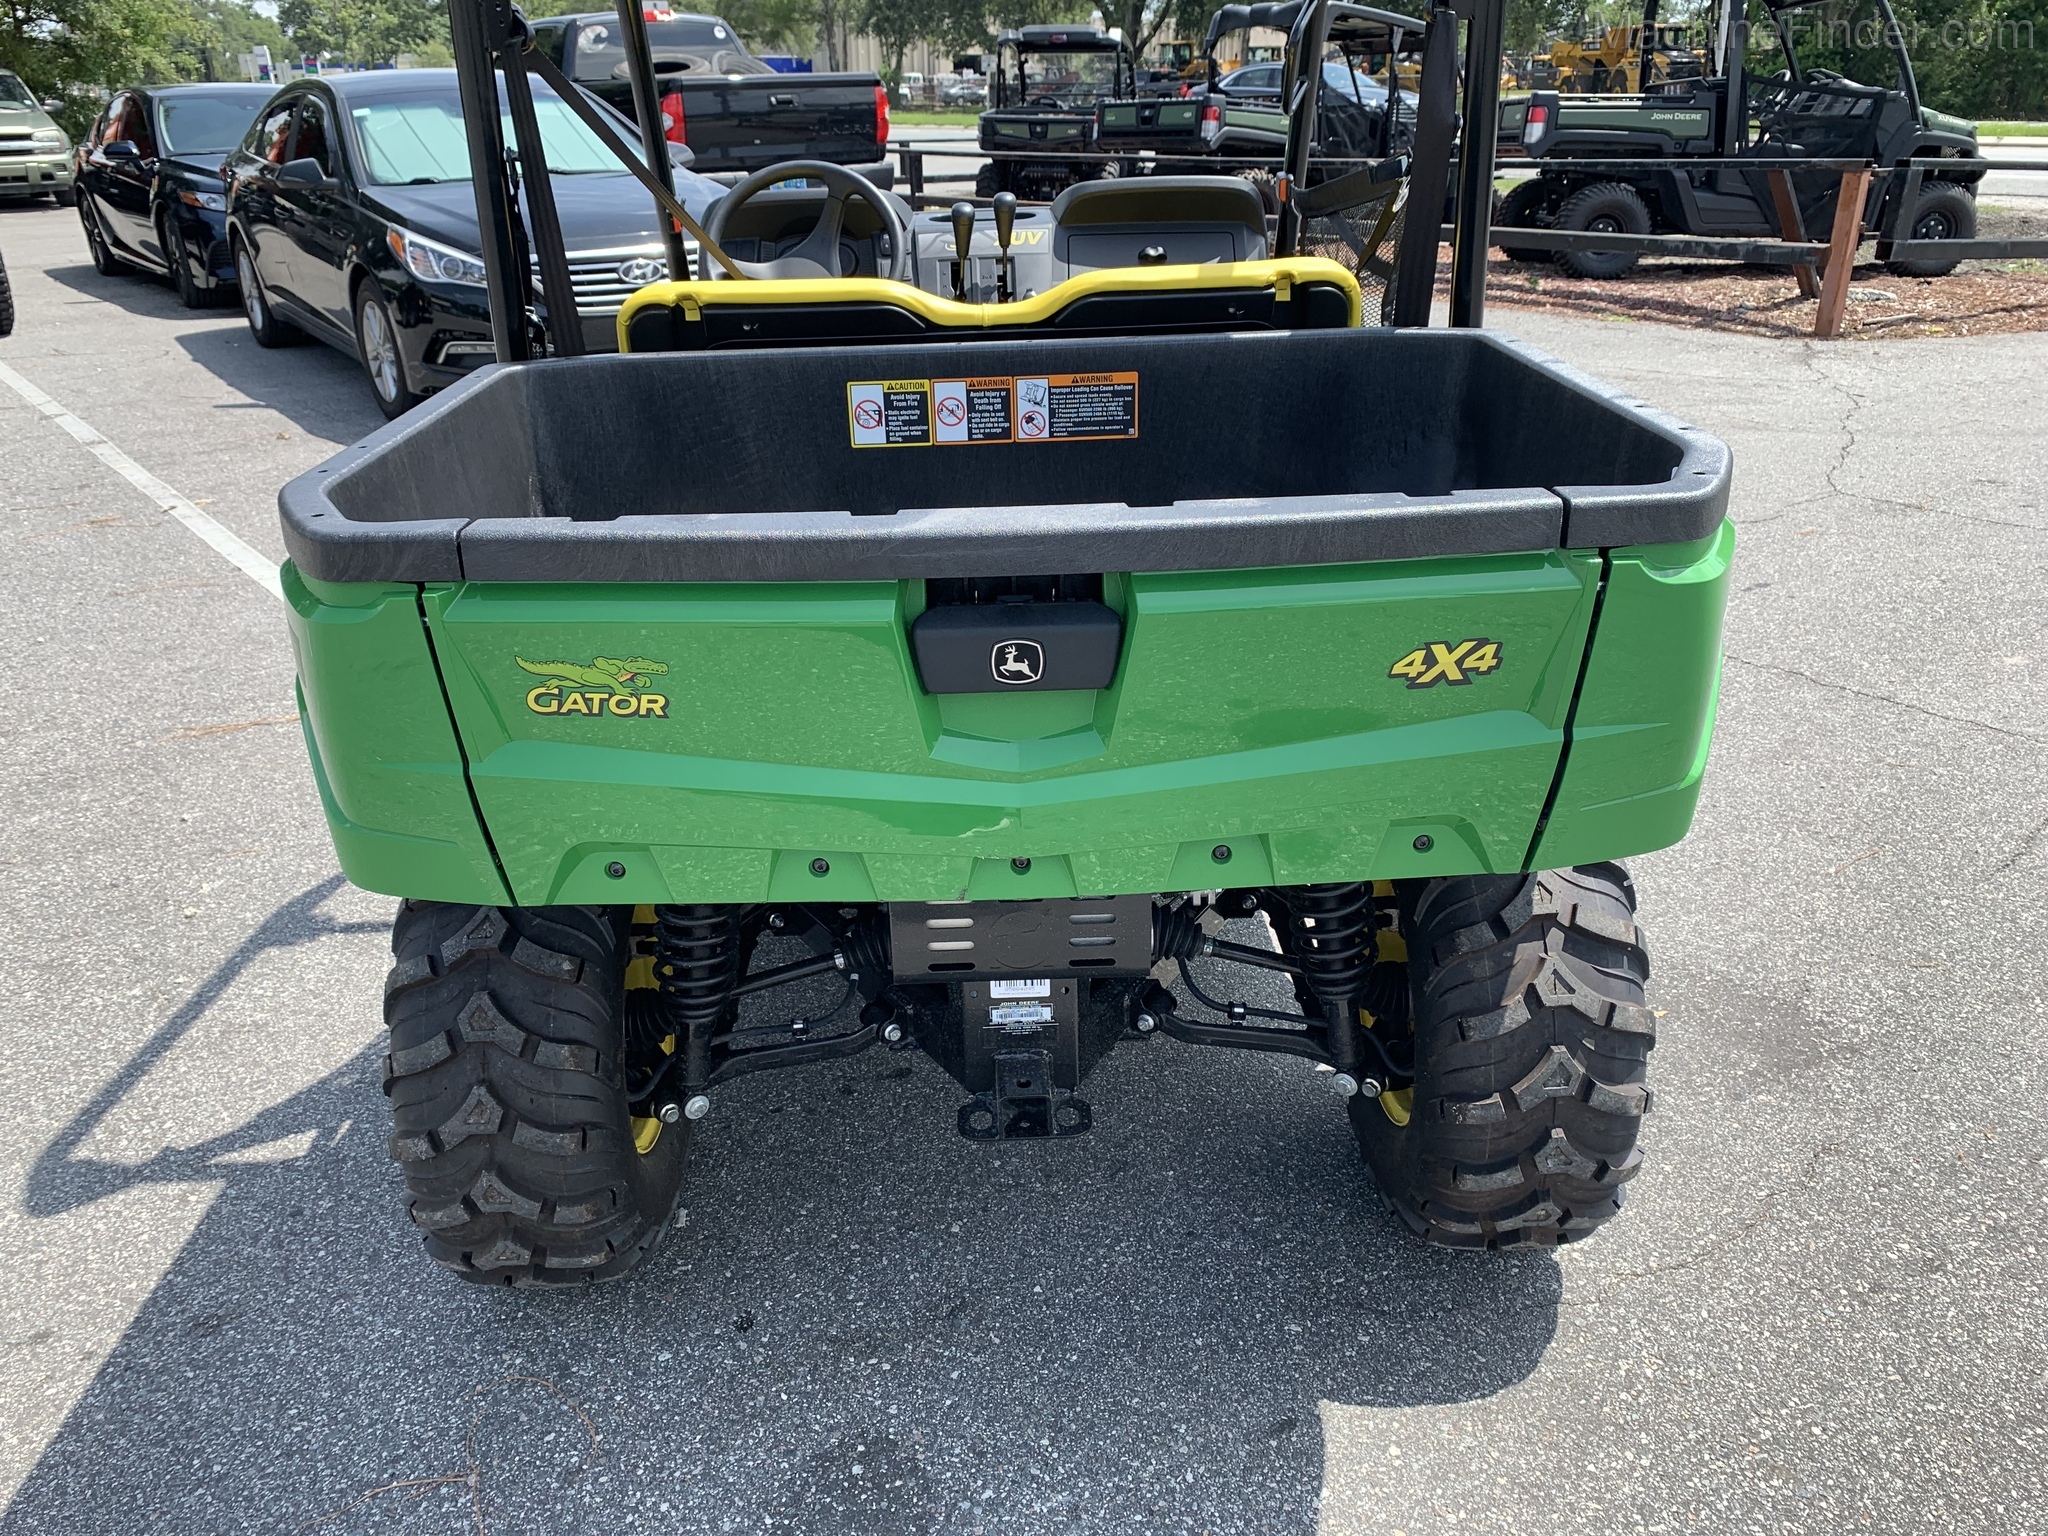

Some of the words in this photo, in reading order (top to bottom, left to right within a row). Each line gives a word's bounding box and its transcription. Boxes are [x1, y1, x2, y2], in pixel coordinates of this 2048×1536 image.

[894, 382, 924, 390] CAUTION
[976, 379, 1010, 387] WARNING
[1389, 638, 1502, 688] 4X4
[526, 685, 669, 718] GATOR
